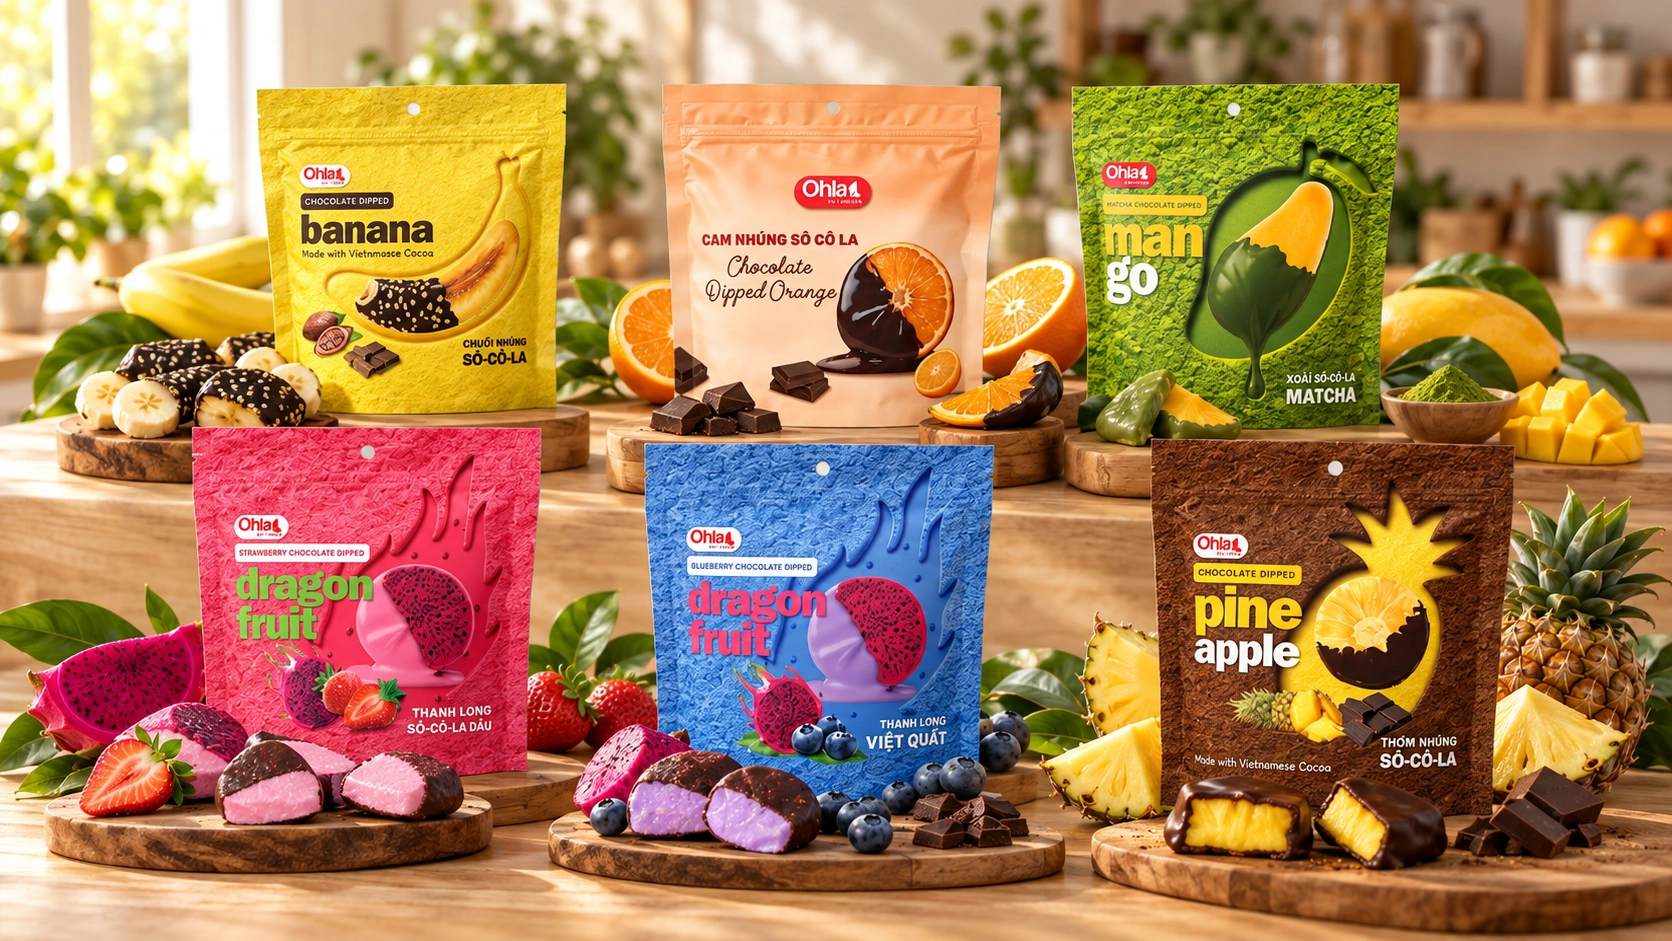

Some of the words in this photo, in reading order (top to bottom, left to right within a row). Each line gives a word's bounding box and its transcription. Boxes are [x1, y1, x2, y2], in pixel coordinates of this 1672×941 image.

[303, 167, 335, 180] Ohla
[1105, 164, 1139, 179] Ohla
[802, 178, 848, 198] Ohla
[304, 197, 357, 206] CHOCOLATE
[359, 196, 390, 205] DIPPED
[301, 213, 434, 245] banana
[702, 233, 732, 246] CAM
[735, 230, 788, 246] NHÚNG
[790, 230, 811, 246] SÔ
[814, 230, 836, 246] CÔ
[839, 233, 859, 246] LA
[1104, 223, 1203, 258] man
[302, 249, 325, 259] Made
[327, 249, 346, 258] with
[404, 248, 434, 258] Cocoa
[727, 254, 813, 278] Chocolate
[1106, 256, 1159, 305] go
[705, 278, 768, 308] Dipped
[769, 279, 838, 308] Orange
[1286, 386, 1357, 405] MATCHA
[238, 517, 272, 532] Ohla
[690, 529, 724, 544] Ohla
[1197, 536, 1231, 550] Ohla
[734, 563, 783, 571] CHOCOLATE
[784, 563, 813, 571] DIPPED
[1198, 569, 1257, 578] CHOCOLATE
[1260, 571, 1296, 579] DIPPED
[236, 566, 374, 608] dragon
[688, 580, 827, 624] dragon
[1194, 585, 1303, 637] pine
[236, 605, 318, 640] fruit
[688, 619, 771, 657] fruit
[1194, 633, 1301, 674] apple
[412, 706, 456, 719] THANH
[459, 705, 492, 717] LONG
[880, 718, 917, 729] THANH
[919, 715, 947, 727] LONG
[865, 731, 904, 752] VIỆT
[1419, 735, 1457, 747] NHÚNG
[1194, 754, 1216, 766] Made
[1217, 757, 1237, 767] with
[1239, 758, 1296, 771] Vietnamese
[1298, 761, 1332, 772] Cocoa
[1380, 749, 1457, 769] SÔ-CÔ-LA
